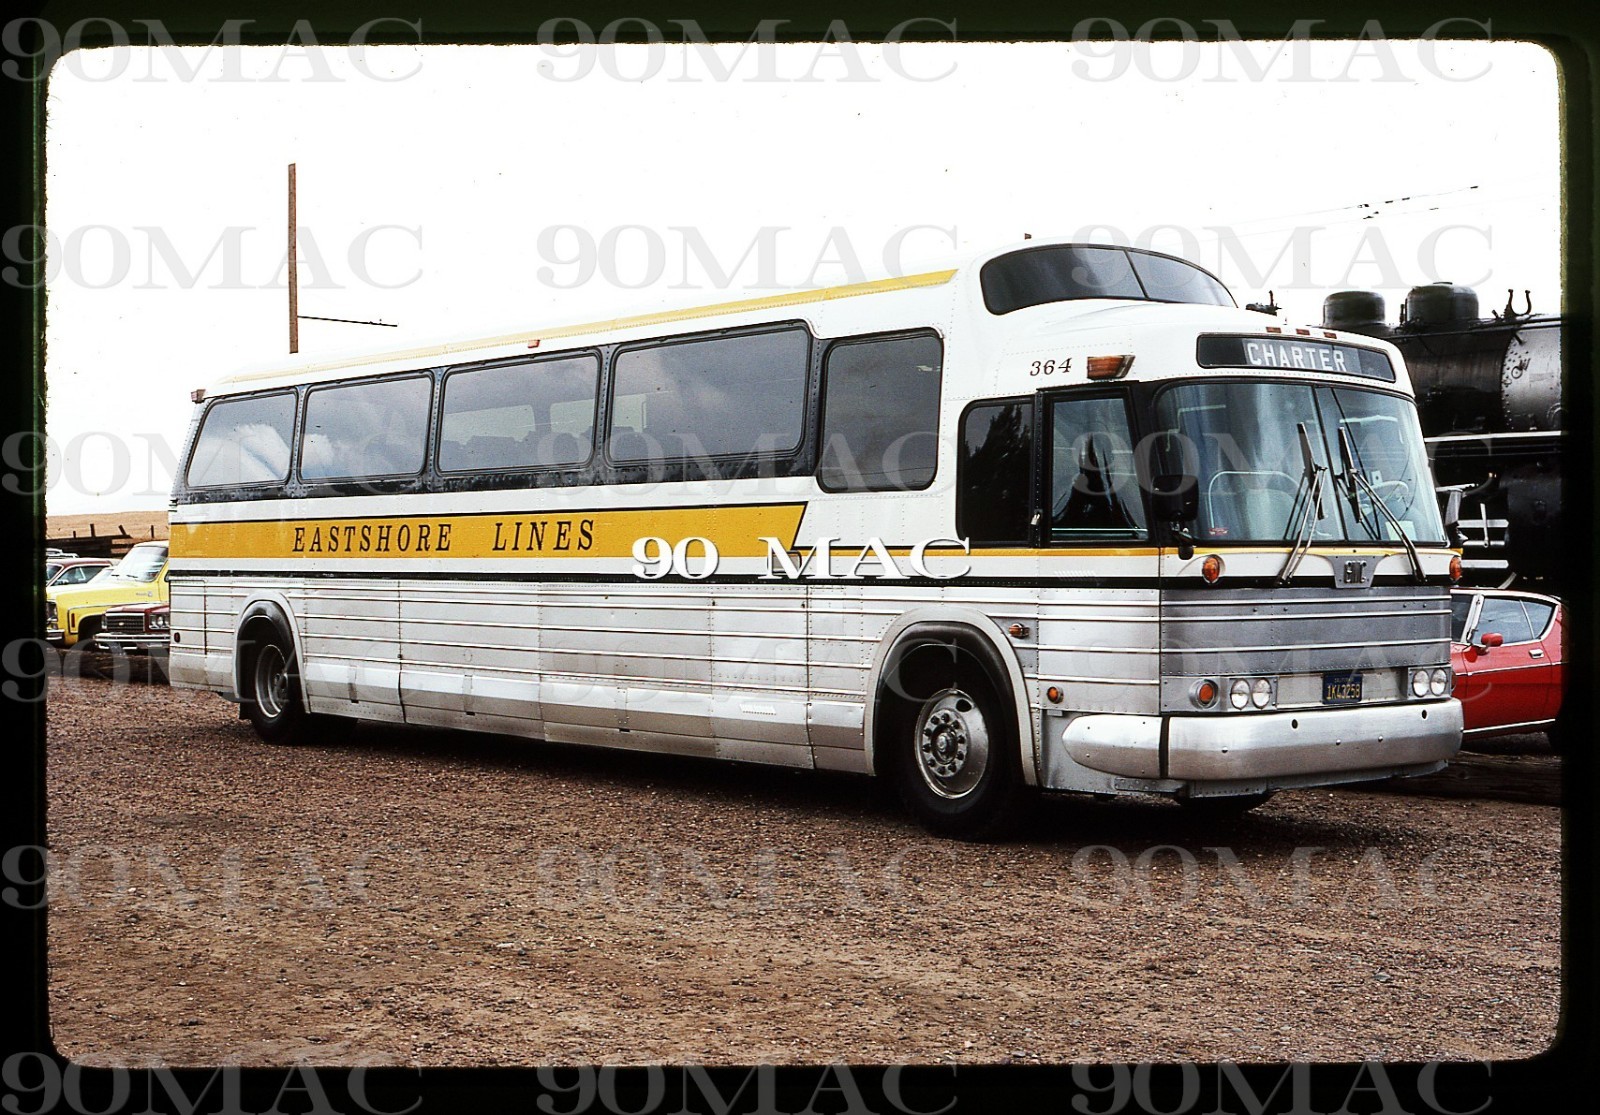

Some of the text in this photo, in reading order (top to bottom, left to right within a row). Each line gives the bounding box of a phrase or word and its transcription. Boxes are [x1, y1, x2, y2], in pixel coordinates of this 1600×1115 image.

[1029, 357, 1073, 377] 364
[1247, 342, 1347, 372] CHARTER
[292, 519, 595, 552] EASTSHORE LINES
